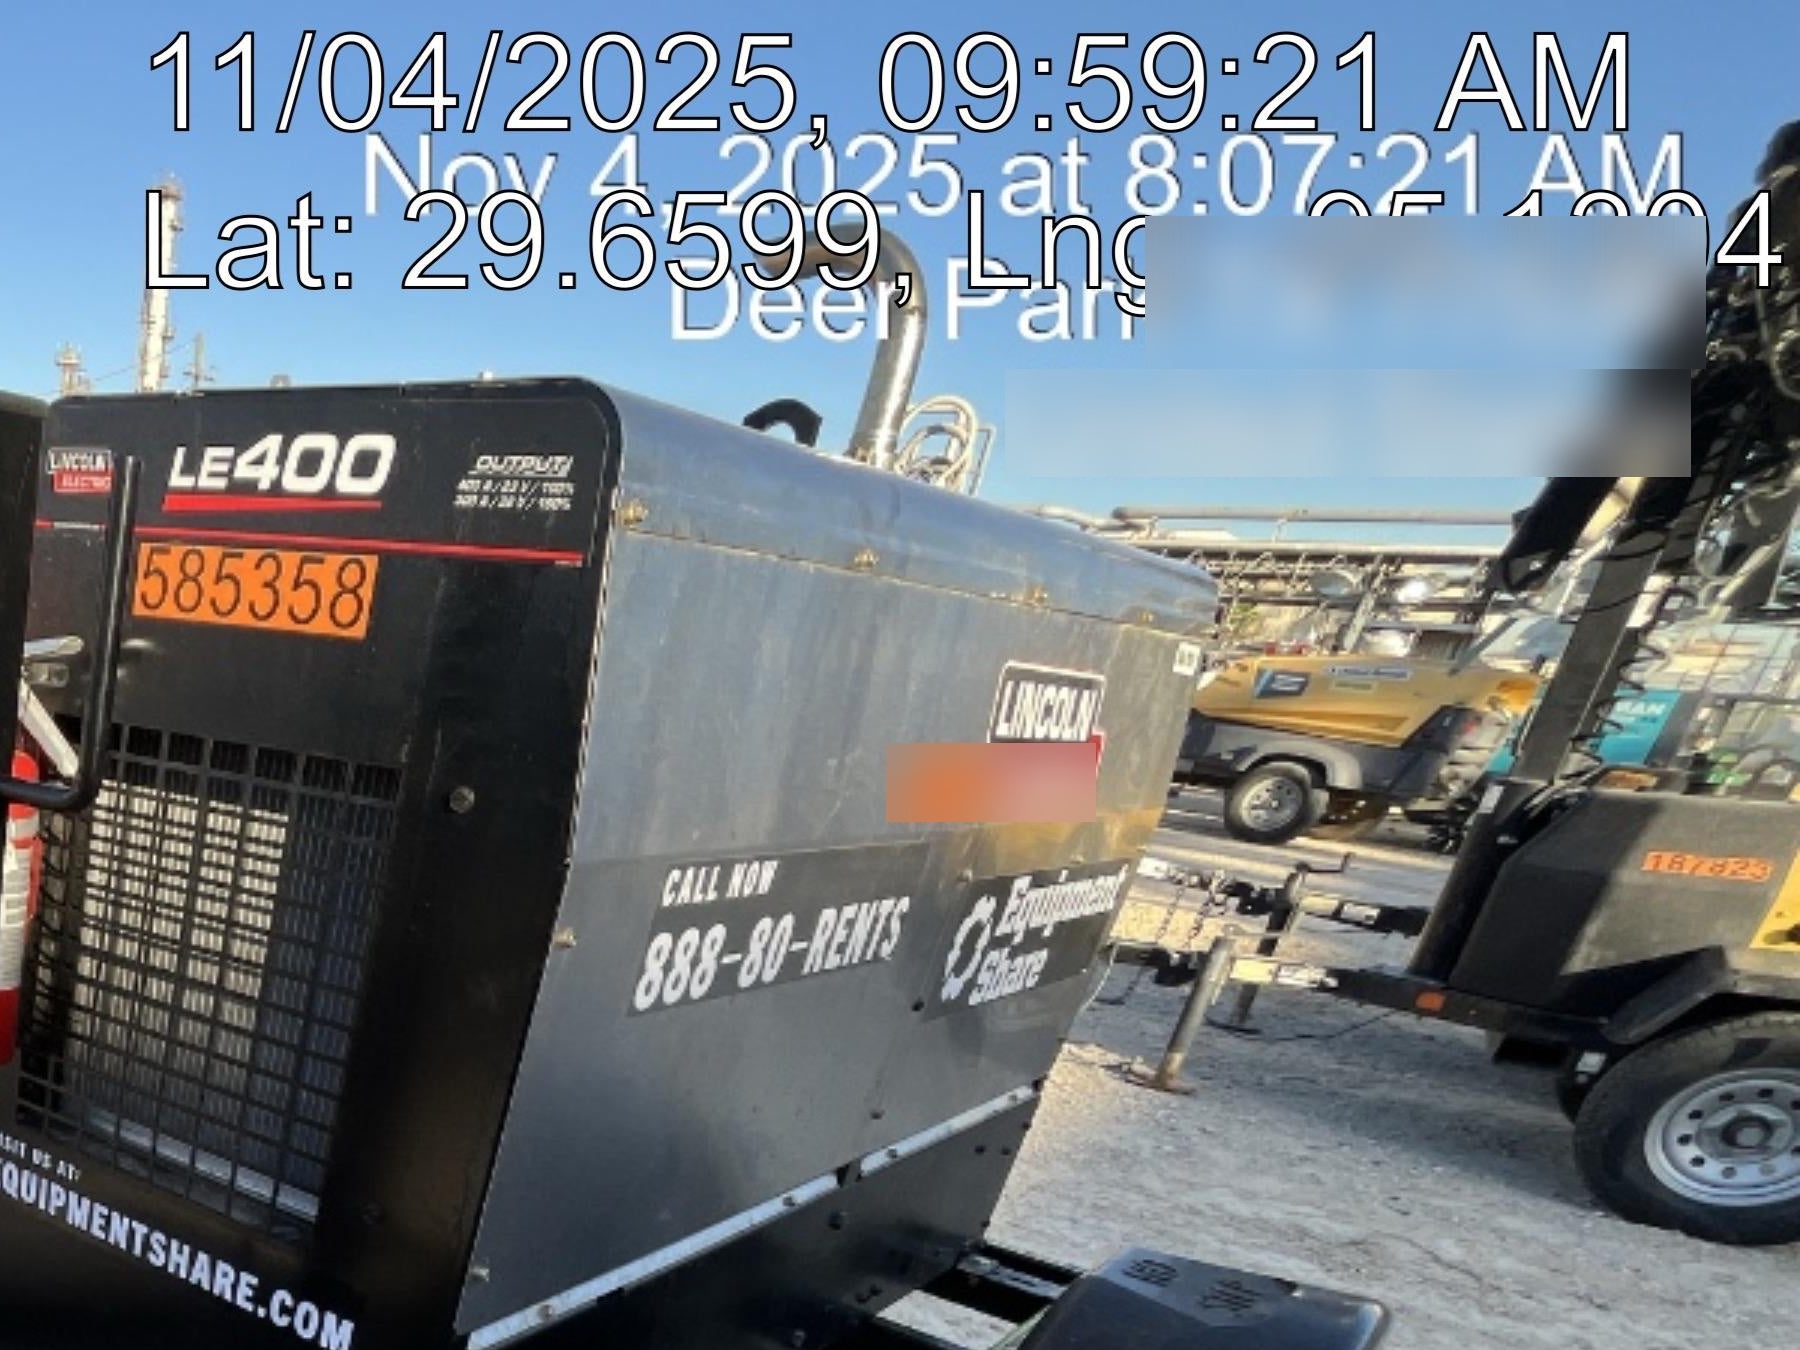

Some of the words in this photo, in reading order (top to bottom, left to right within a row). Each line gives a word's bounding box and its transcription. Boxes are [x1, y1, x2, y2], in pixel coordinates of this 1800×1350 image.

[168, 434, 396, 493] LE400
[140, 549, 367, 629] 585358
[995, 680, 1098, 741] LINCOLN
[661, 865, 720, 907] CALL
[726, 860, 779, 898] NOW
[995, 863, 1129, 946] Equipment
[633, 896, 910, 1011] 888-80-RENTS
[968, 948, 1048, 1006] Share
